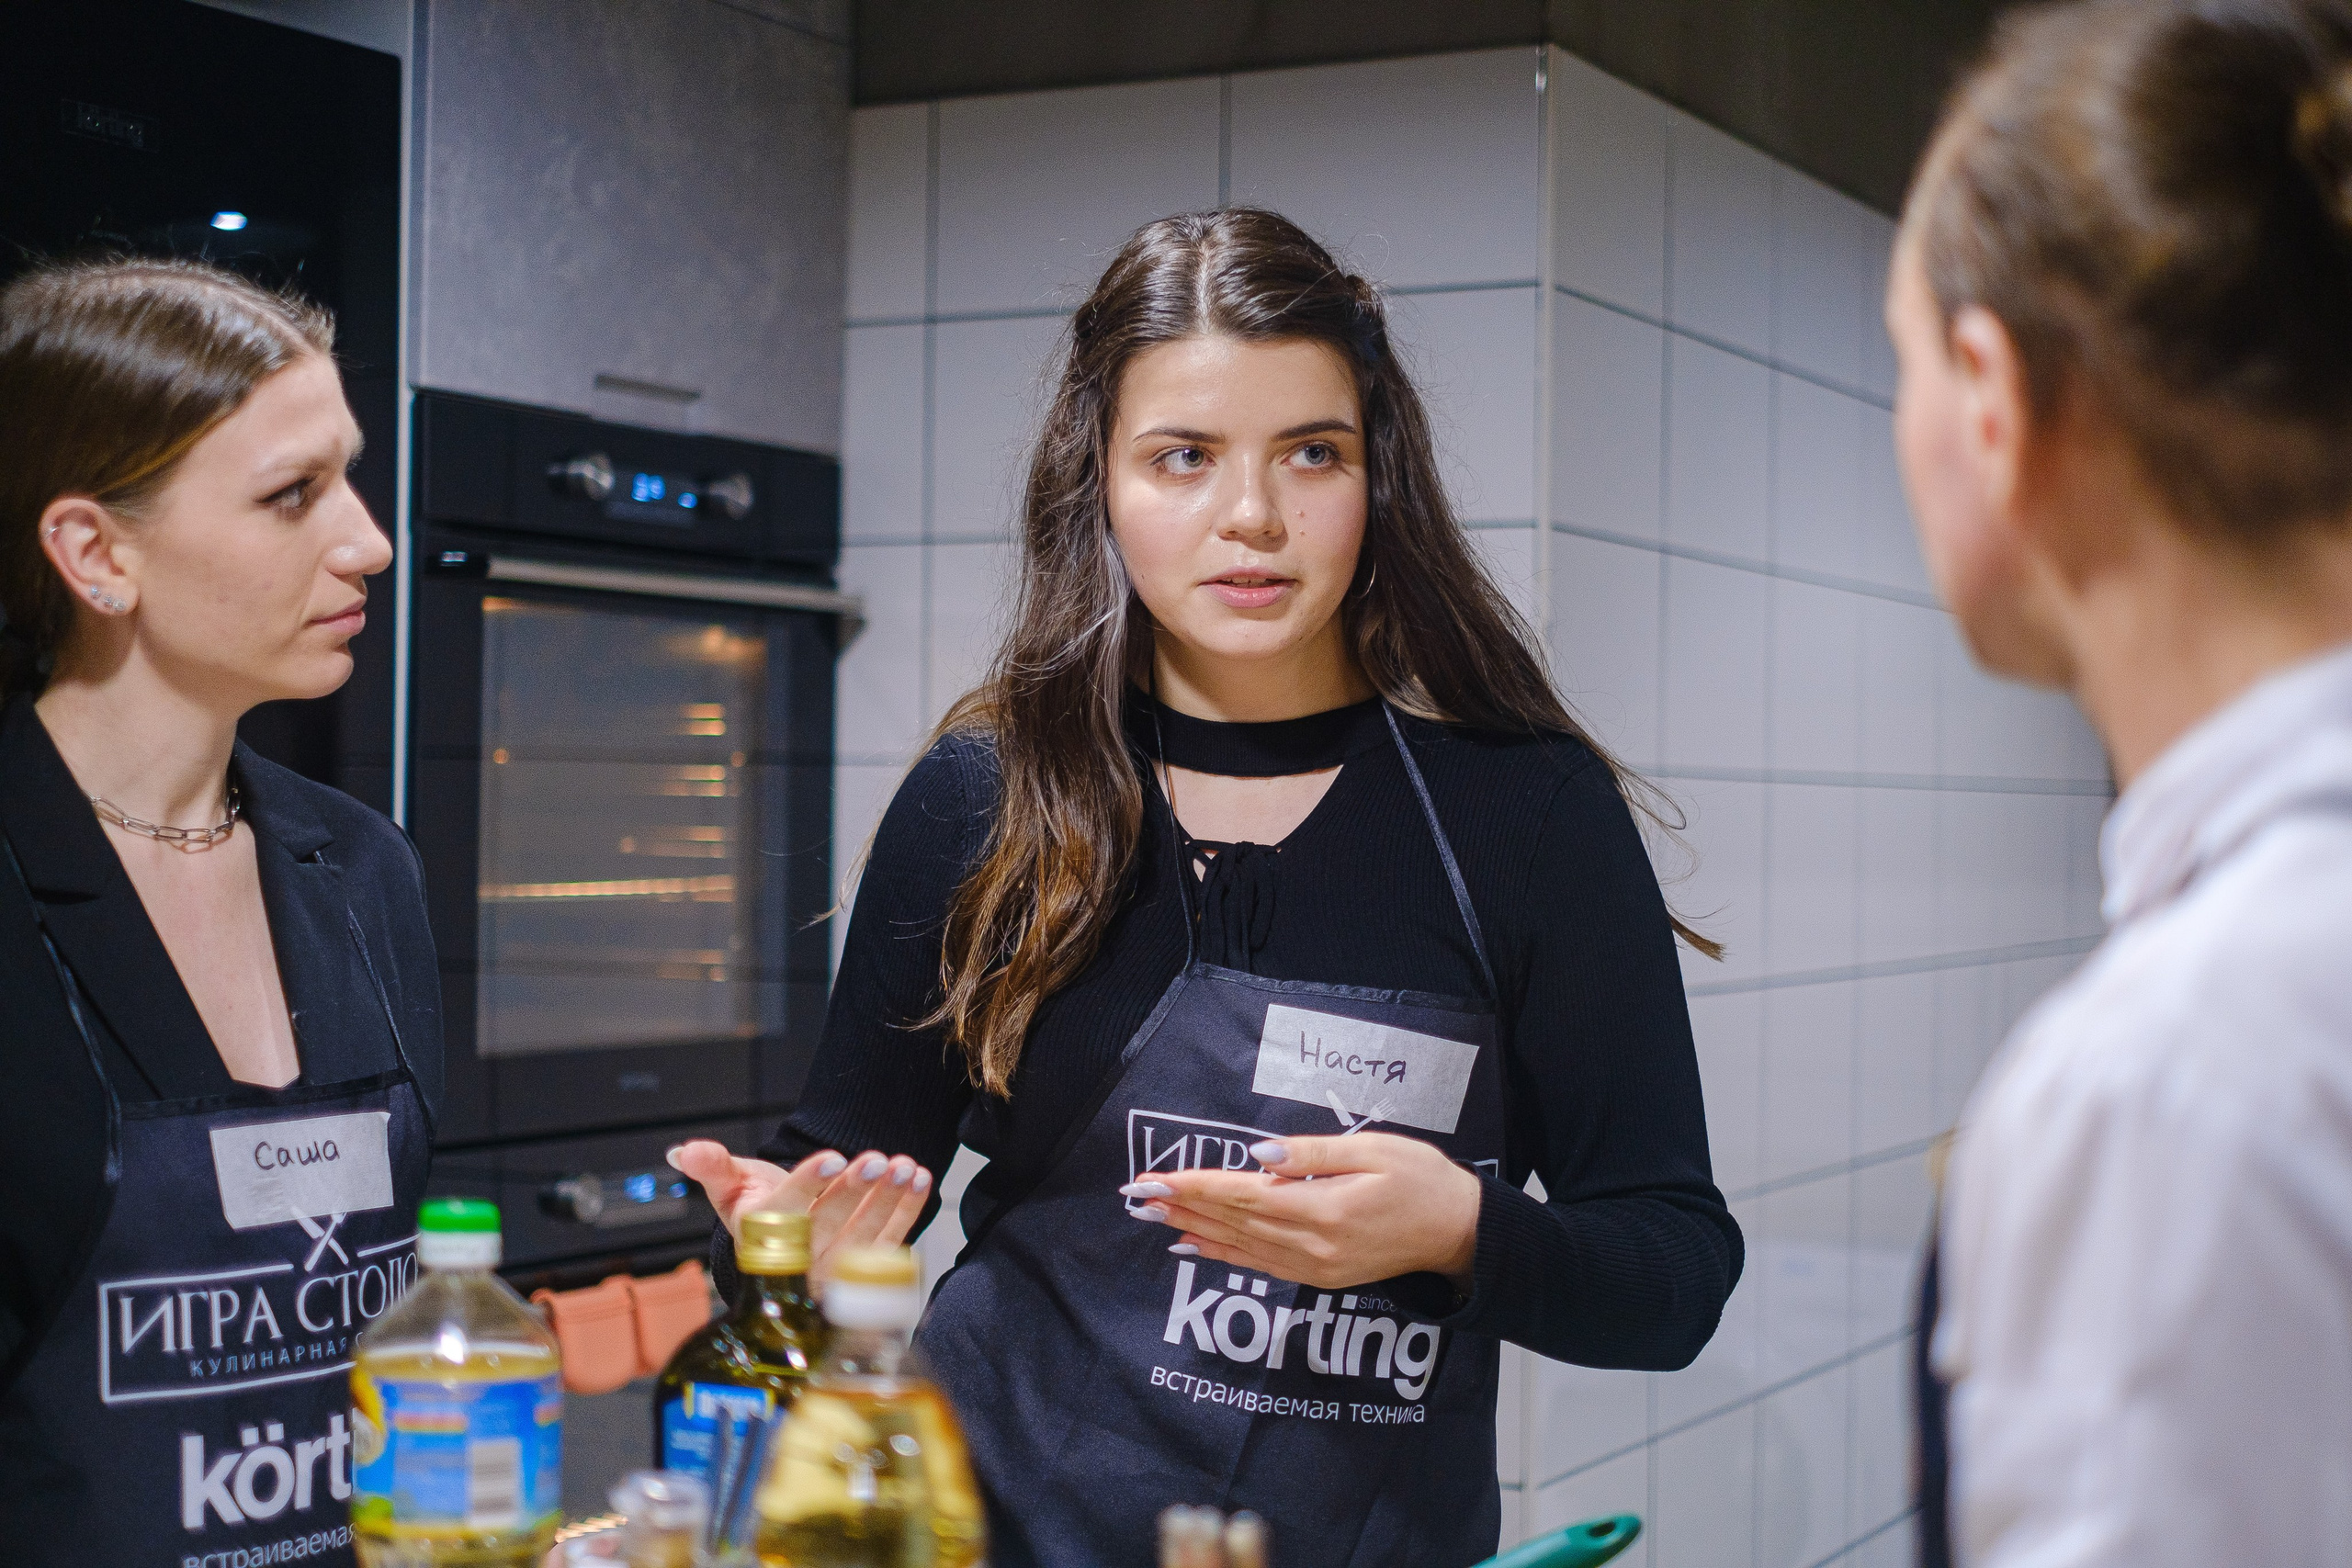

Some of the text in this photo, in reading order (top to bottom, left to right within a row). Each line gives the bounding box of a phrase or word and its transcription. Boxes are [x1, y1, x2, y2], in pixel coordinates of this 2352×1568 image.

[1300, 1030, 1407, 1085] Настя
[254, 1139, 341, 1171] Саша
[1143, 1126, 1278, 1175] ИГР
[119, 1286, 284, 1355] ИГРА
[1162, 1259, 1441, 1401] körting
[189, 1337, 348, 1378] КУЛИНАРНАЯ
[1150, 1365, 1425, 1425] встраиваемая техника
[183, 1413, 356, 1529] kört
